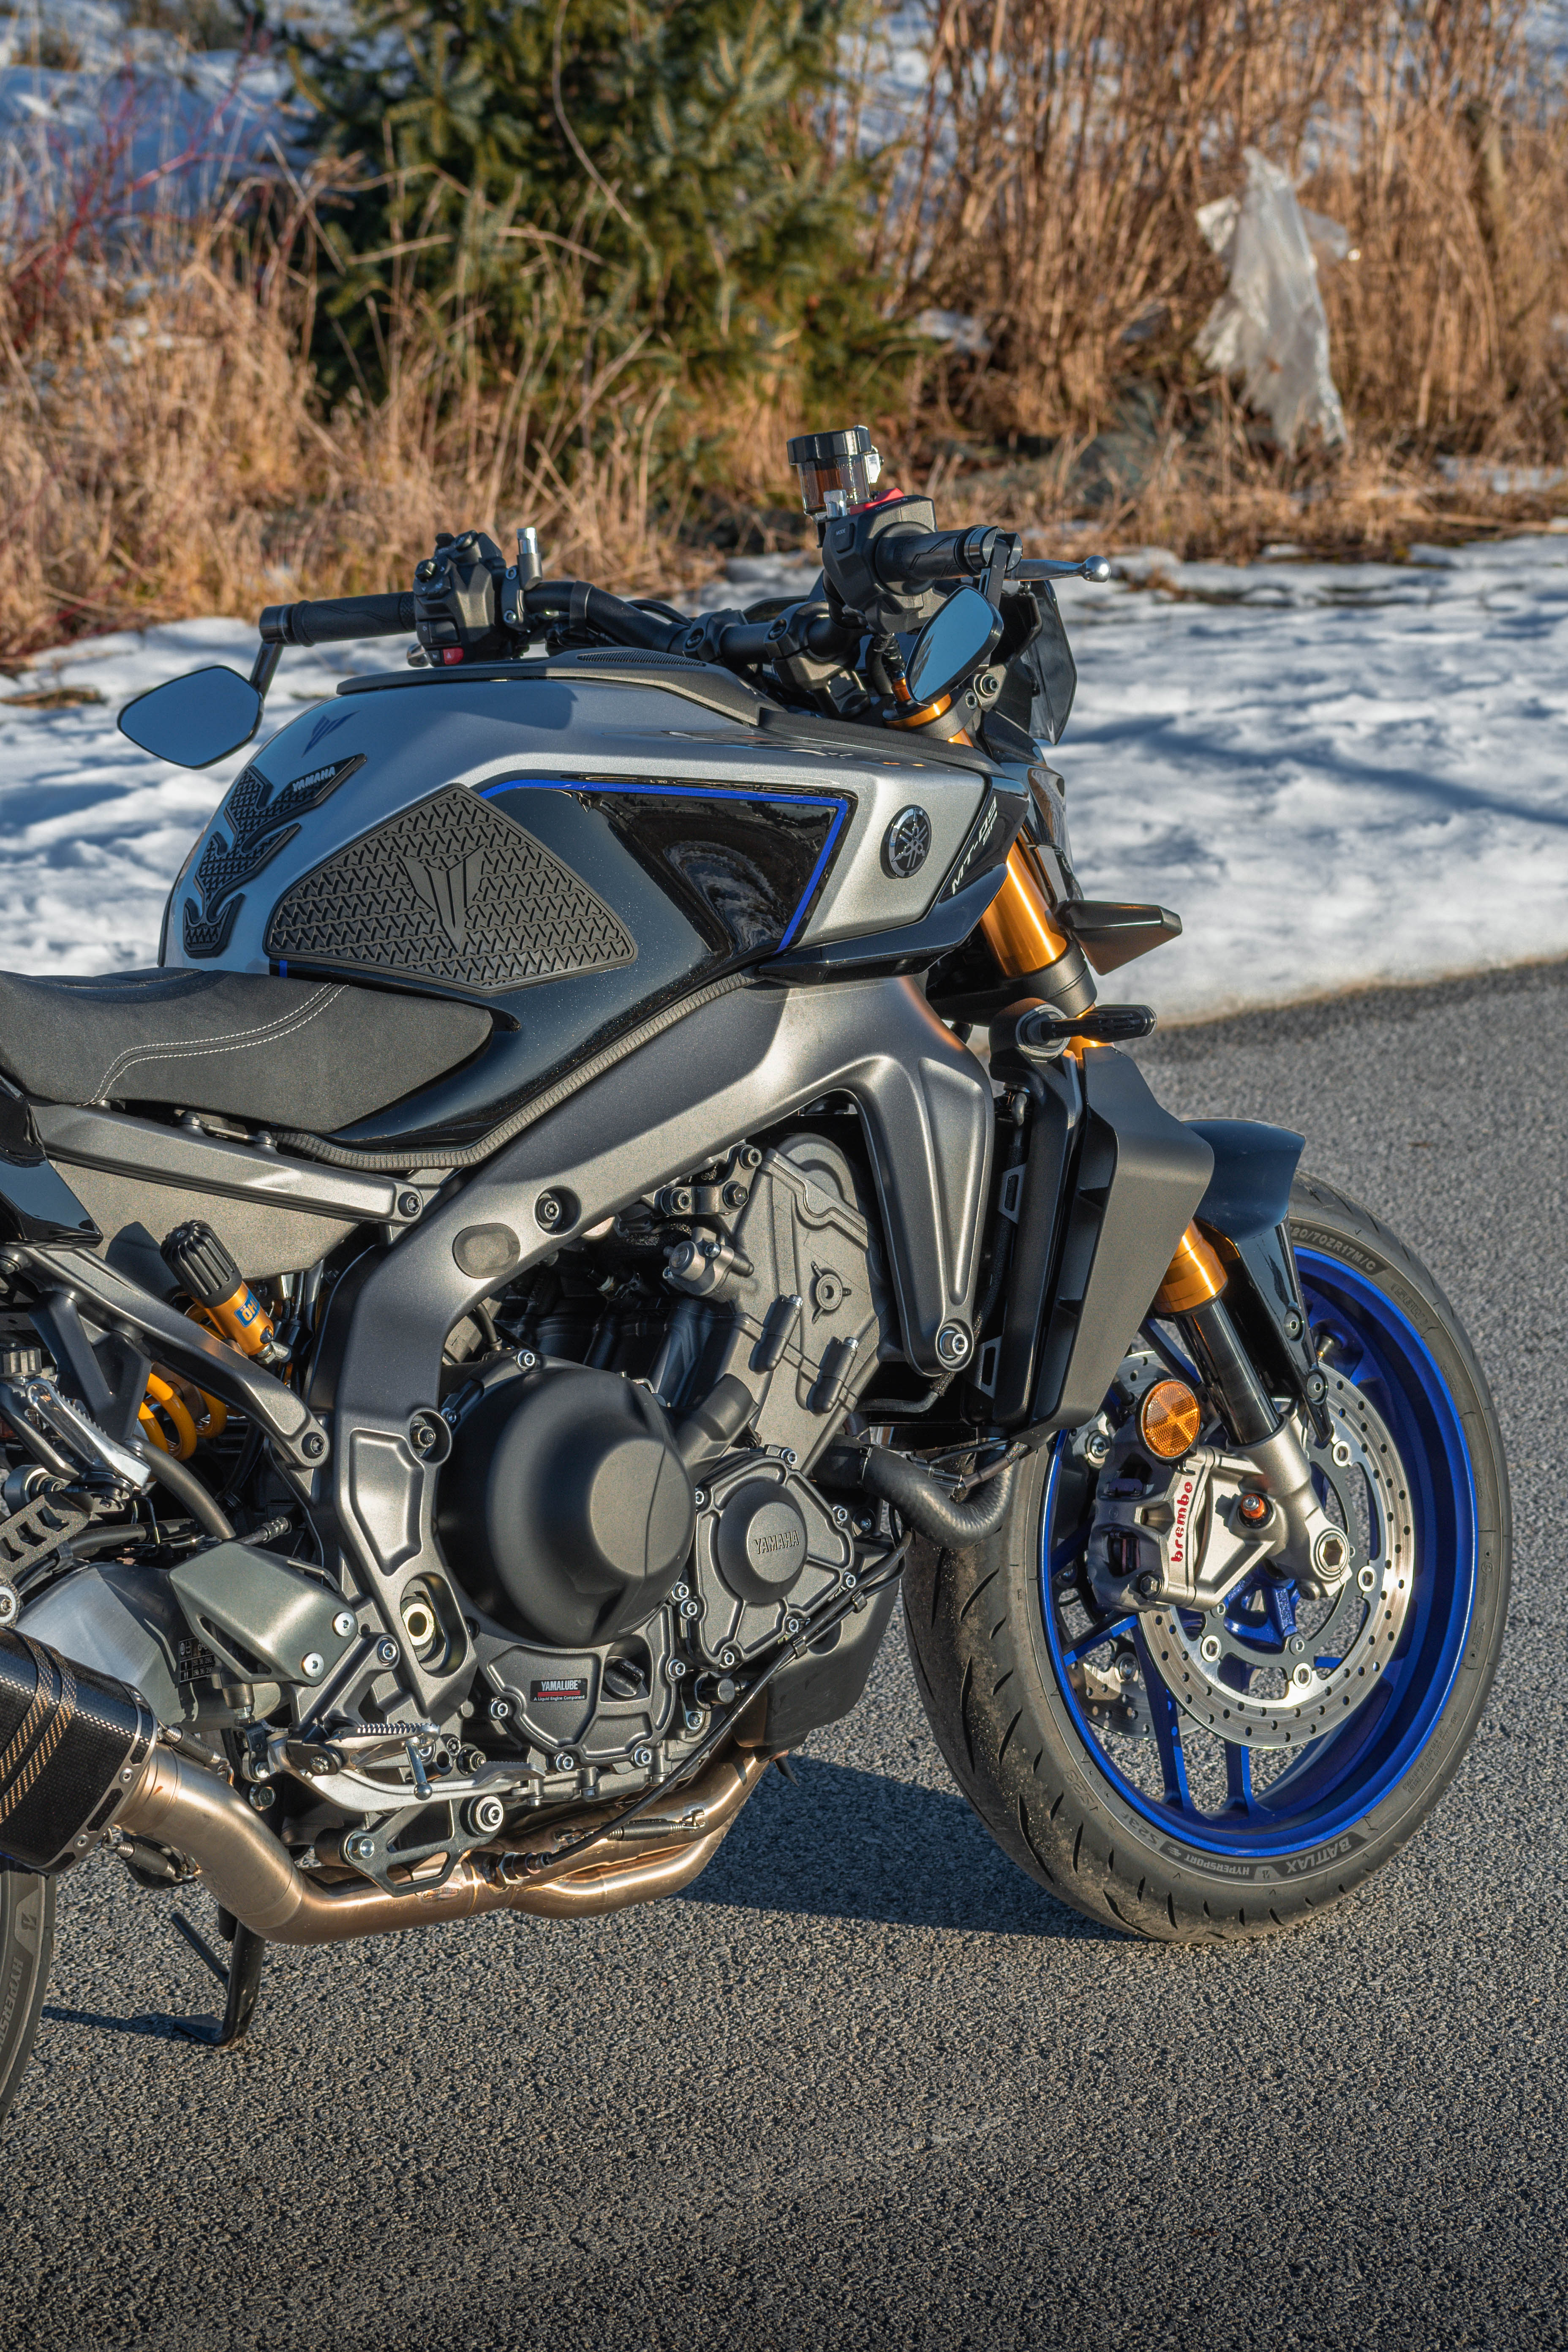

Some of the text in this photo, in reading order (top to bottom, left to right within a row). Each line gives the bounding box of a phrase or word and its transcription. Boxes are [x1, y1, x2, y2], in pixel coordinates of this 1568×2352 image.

[293, 766, 335, 792] YAMAHA
[952, 796, 996, 895] MT-09
[983, 810, 997, 846] SP
[1290, 1226, 1376, 1271] 20/70ZR17M/C
[1171, 1481, 1193, 1562] brembo
[753, 1530, 800, 1554] YAMAHA
[1184, 1854, 1250, 1875] HYPERSPORT
[1285, 1837, 1352, 1874] BATTLAX
